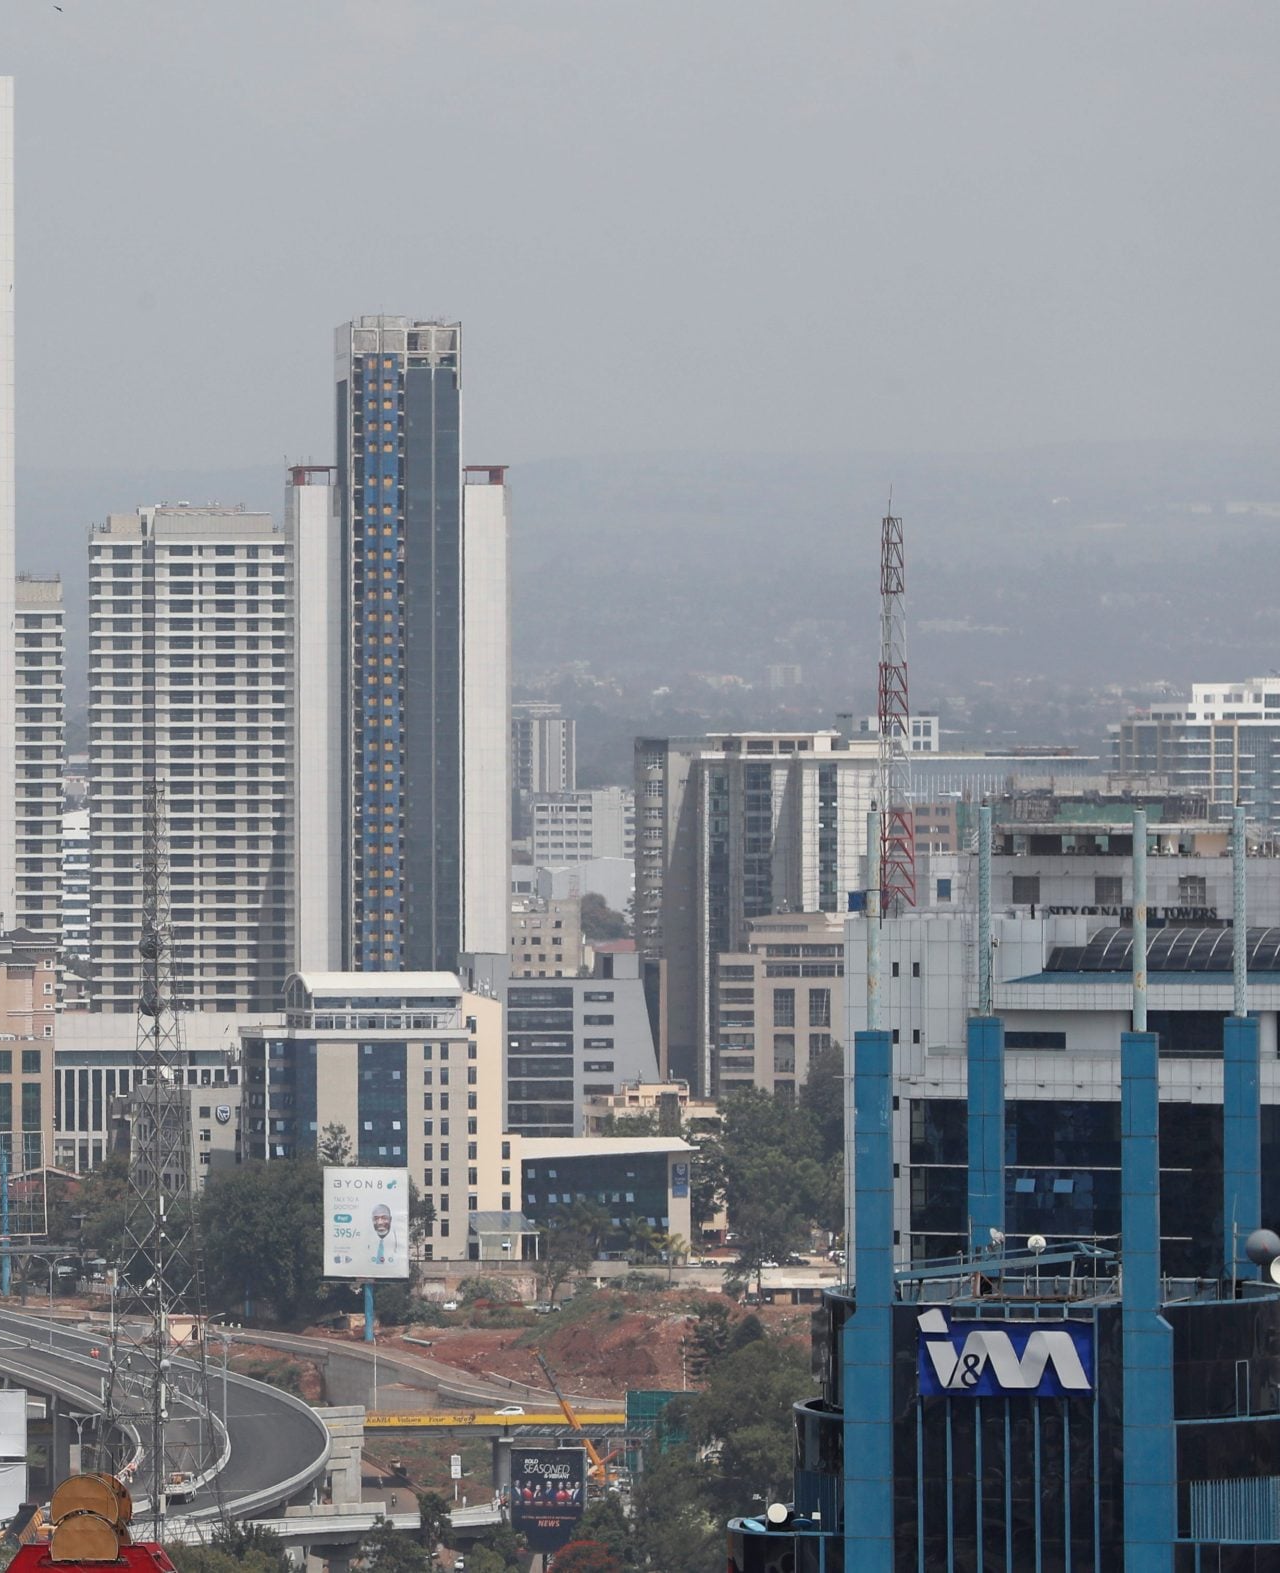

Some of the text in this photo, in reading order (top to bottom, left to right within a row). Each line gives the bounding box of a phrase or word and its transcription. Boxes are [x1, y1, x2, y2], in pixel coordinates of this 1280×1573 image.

[1101, 906, 1157, 919] NAIRBI
[1161, 907, 1217, 919] TOWERS
[523, 1464, 570, 1474] SEASONED
[538, 1520, 560, 1528] NEWS
